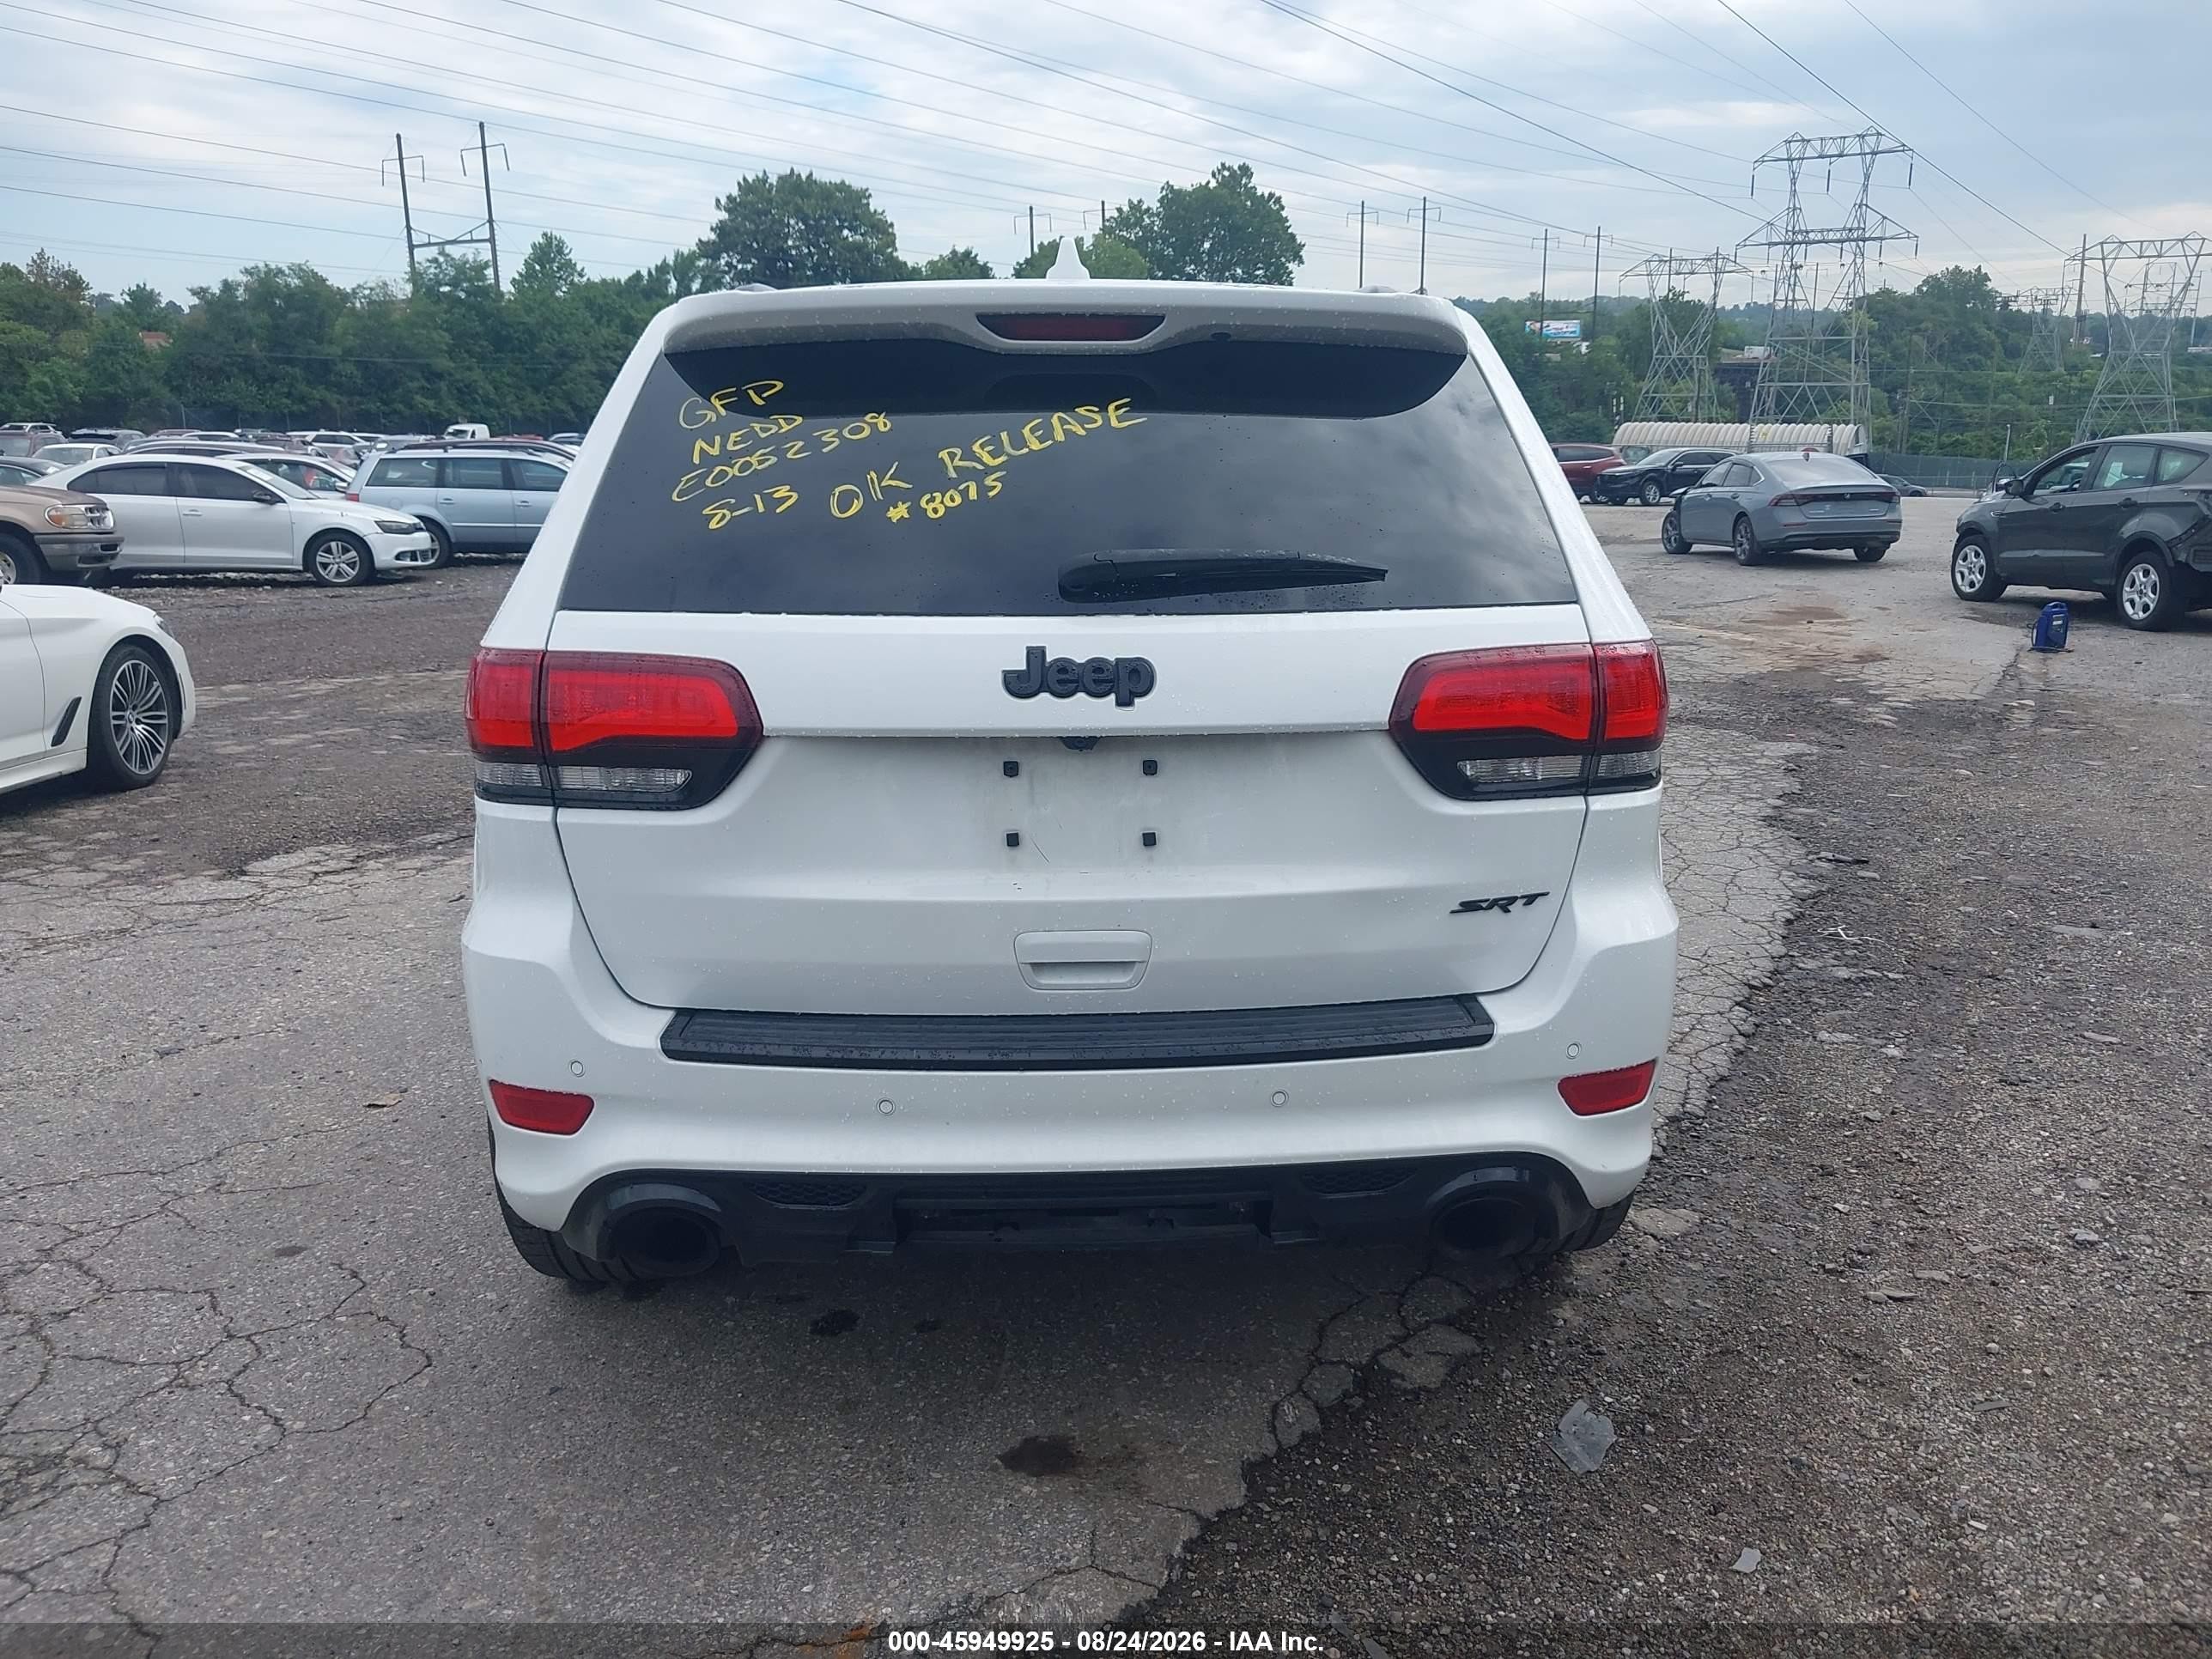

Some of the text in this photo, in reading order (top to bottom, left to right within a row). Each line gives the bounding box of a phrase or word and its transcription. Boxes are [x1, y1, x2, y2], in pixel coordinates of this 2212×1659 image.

[829, 398, 1148, 519] OK RELEASE
[1002, 646, 1156, 707] Jeep
[1449, 891, 1550, 914] SRT
